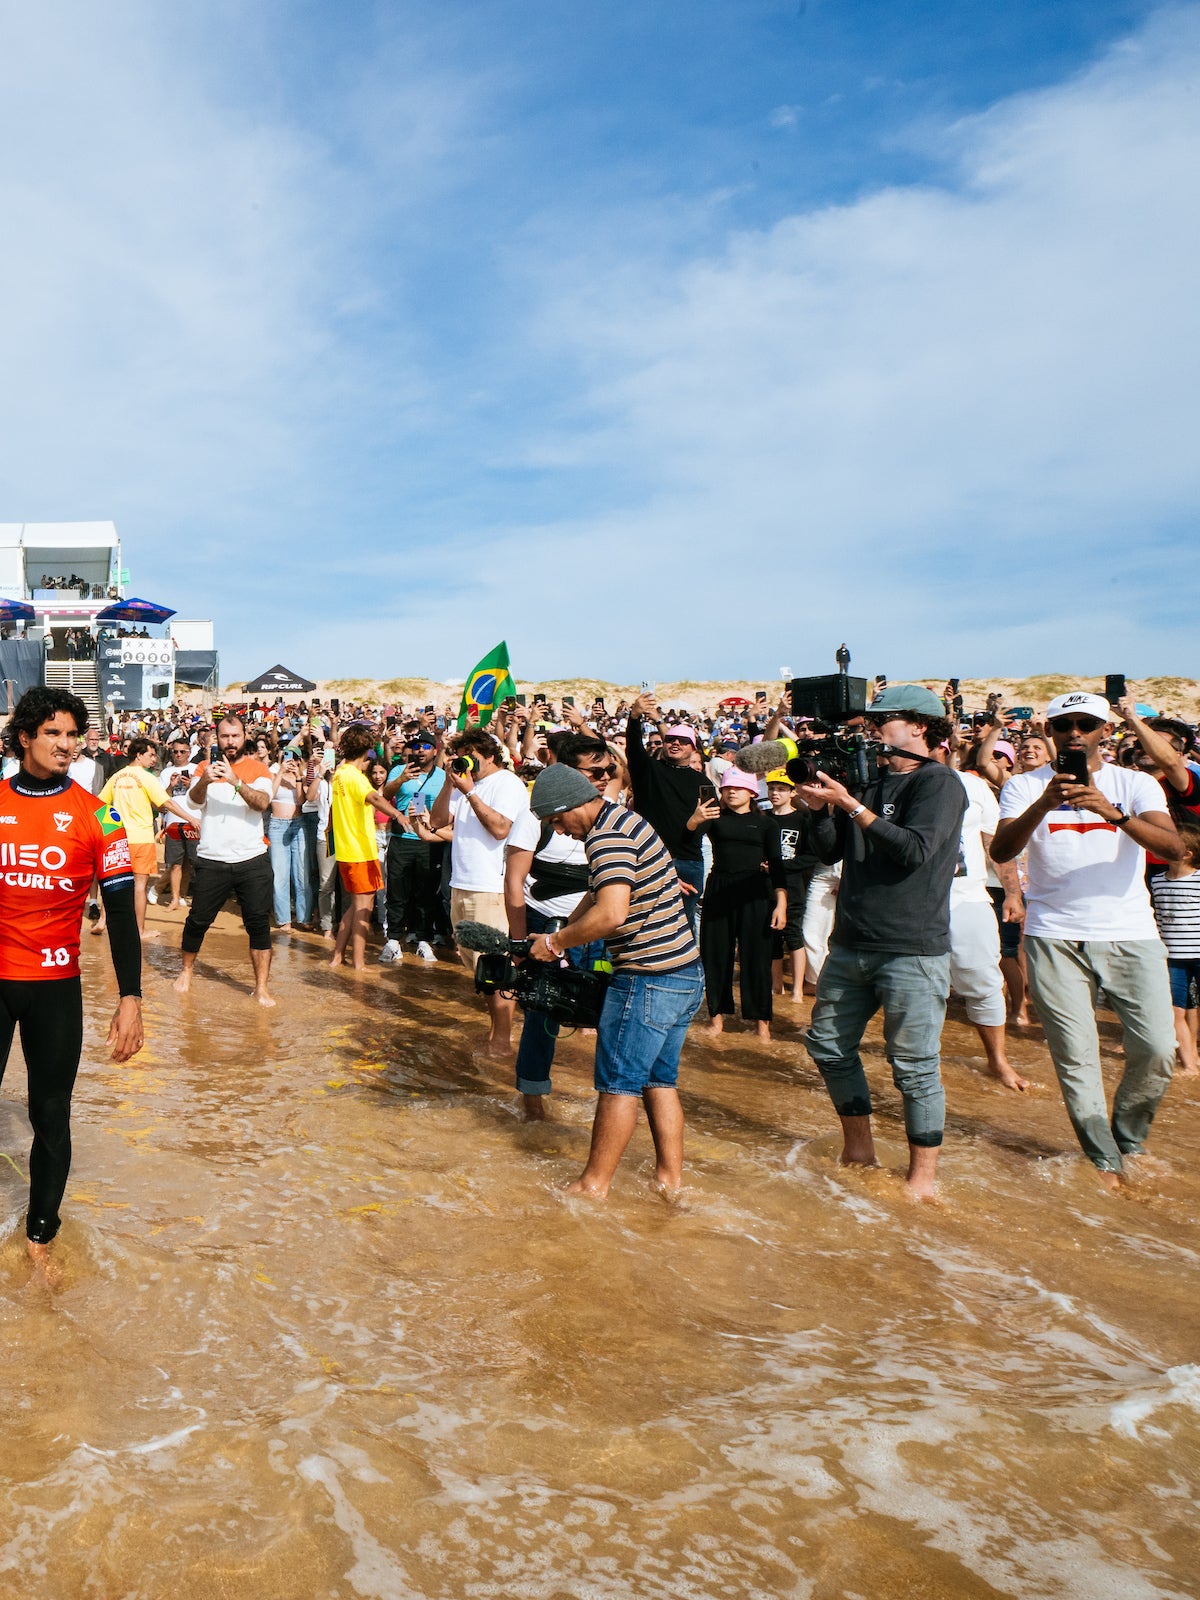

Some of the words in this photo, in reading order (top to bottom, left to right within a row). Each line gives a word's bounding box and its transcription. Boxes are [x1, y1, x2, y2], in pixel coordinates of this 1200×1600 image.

[1068, 695, 1089, 703] NIKE
[4, 872, 54, 890] CURL
[41, 947, 70, 967] 10
